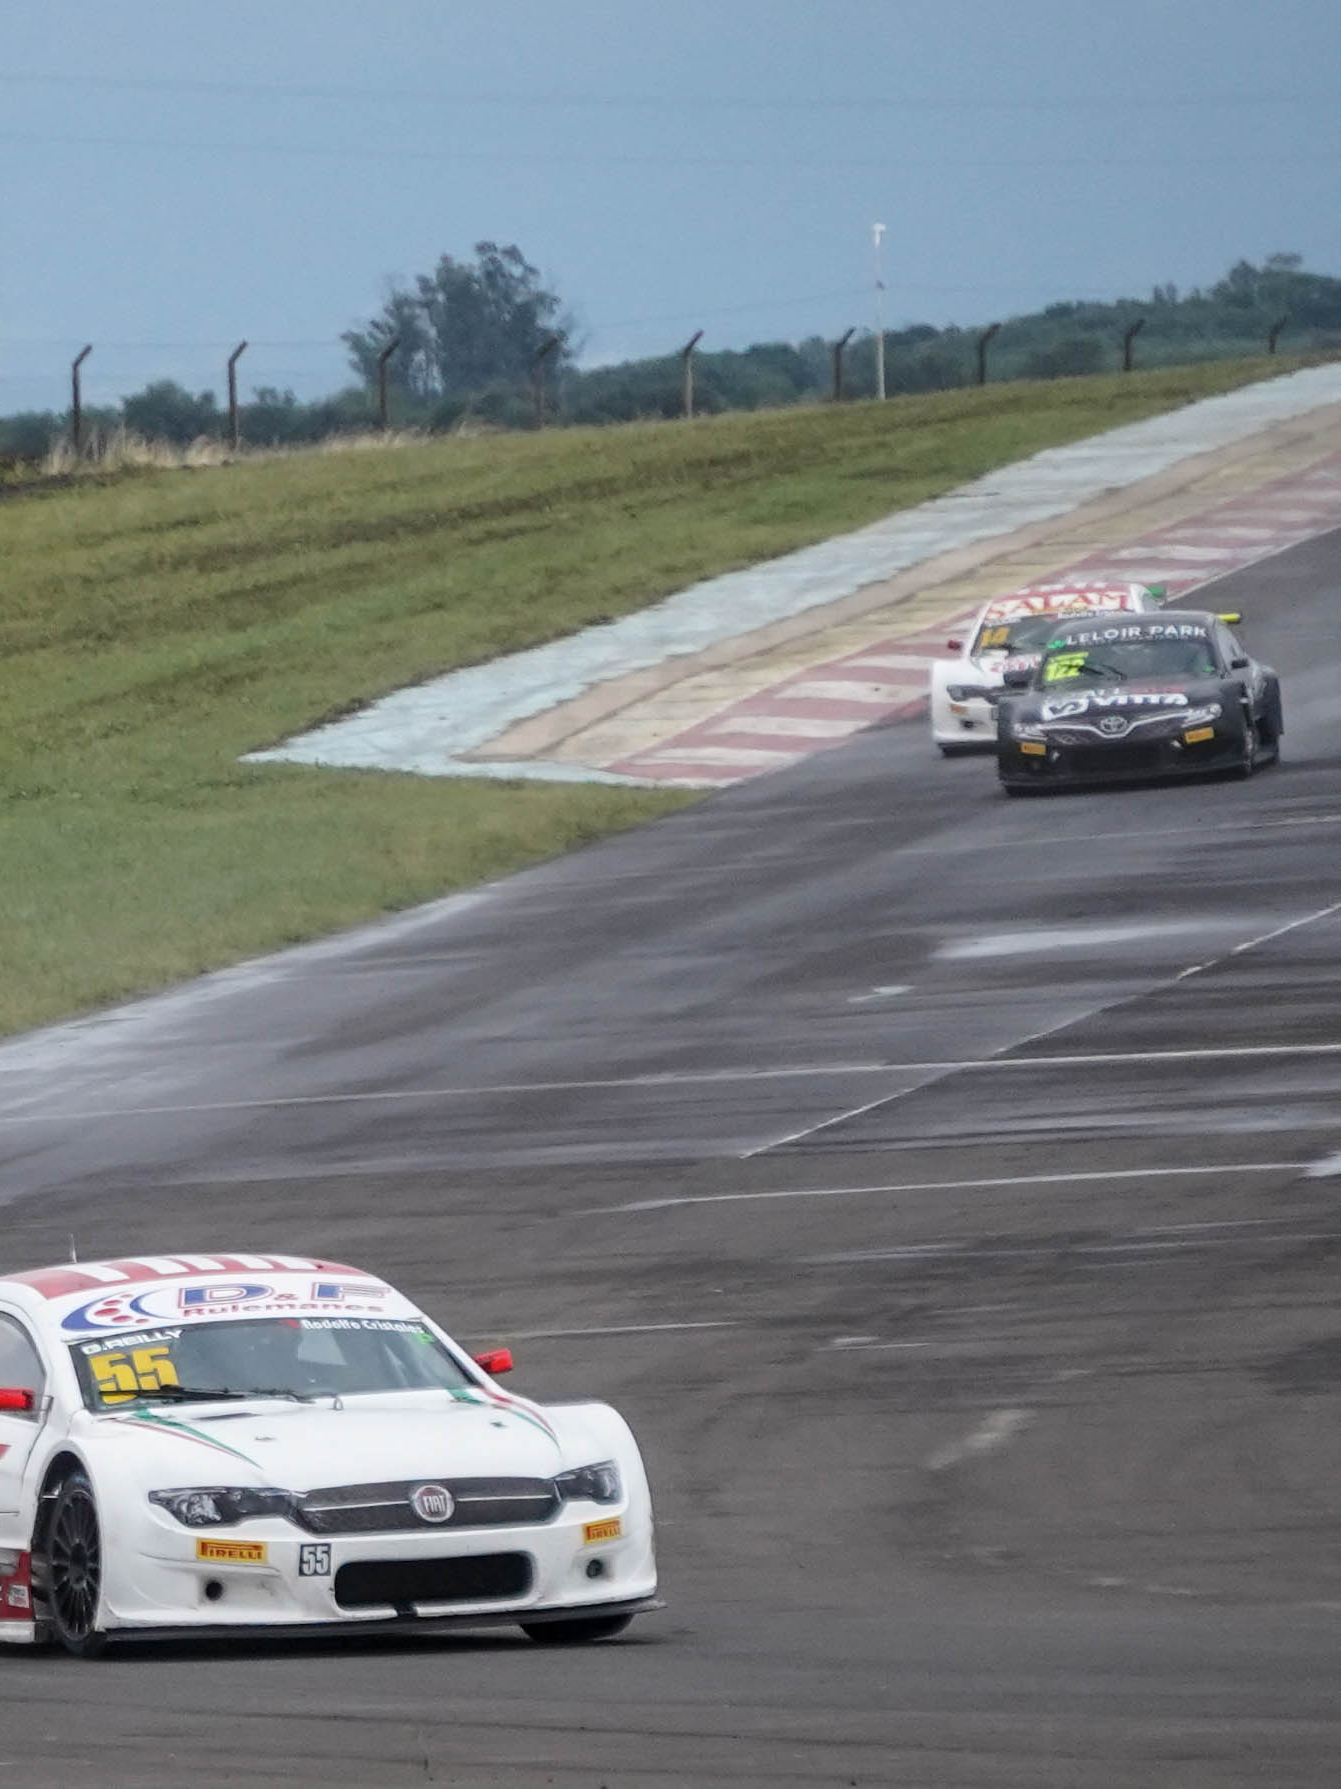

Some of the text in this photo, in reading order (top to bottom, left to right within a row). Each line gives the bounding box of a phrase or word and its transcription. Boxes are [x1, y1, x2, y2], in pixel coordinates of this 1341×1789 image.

[1066, 626, 1140, 646] LELOIR
[1150, 624, 1207, 638] PARK
[178, 1283, 276, 1310] D
[183, 1303, 384, 1317] Rulemanes
[301, 1319, 426, 1334] Rodolfo Cristales
[89, 1346, 179, 1405] 55
[424, 1495, 446, 1512] FIAT
[201, 1541, 264, 1560] PIRELLI
[301, 1545, 329, 1576] 55
